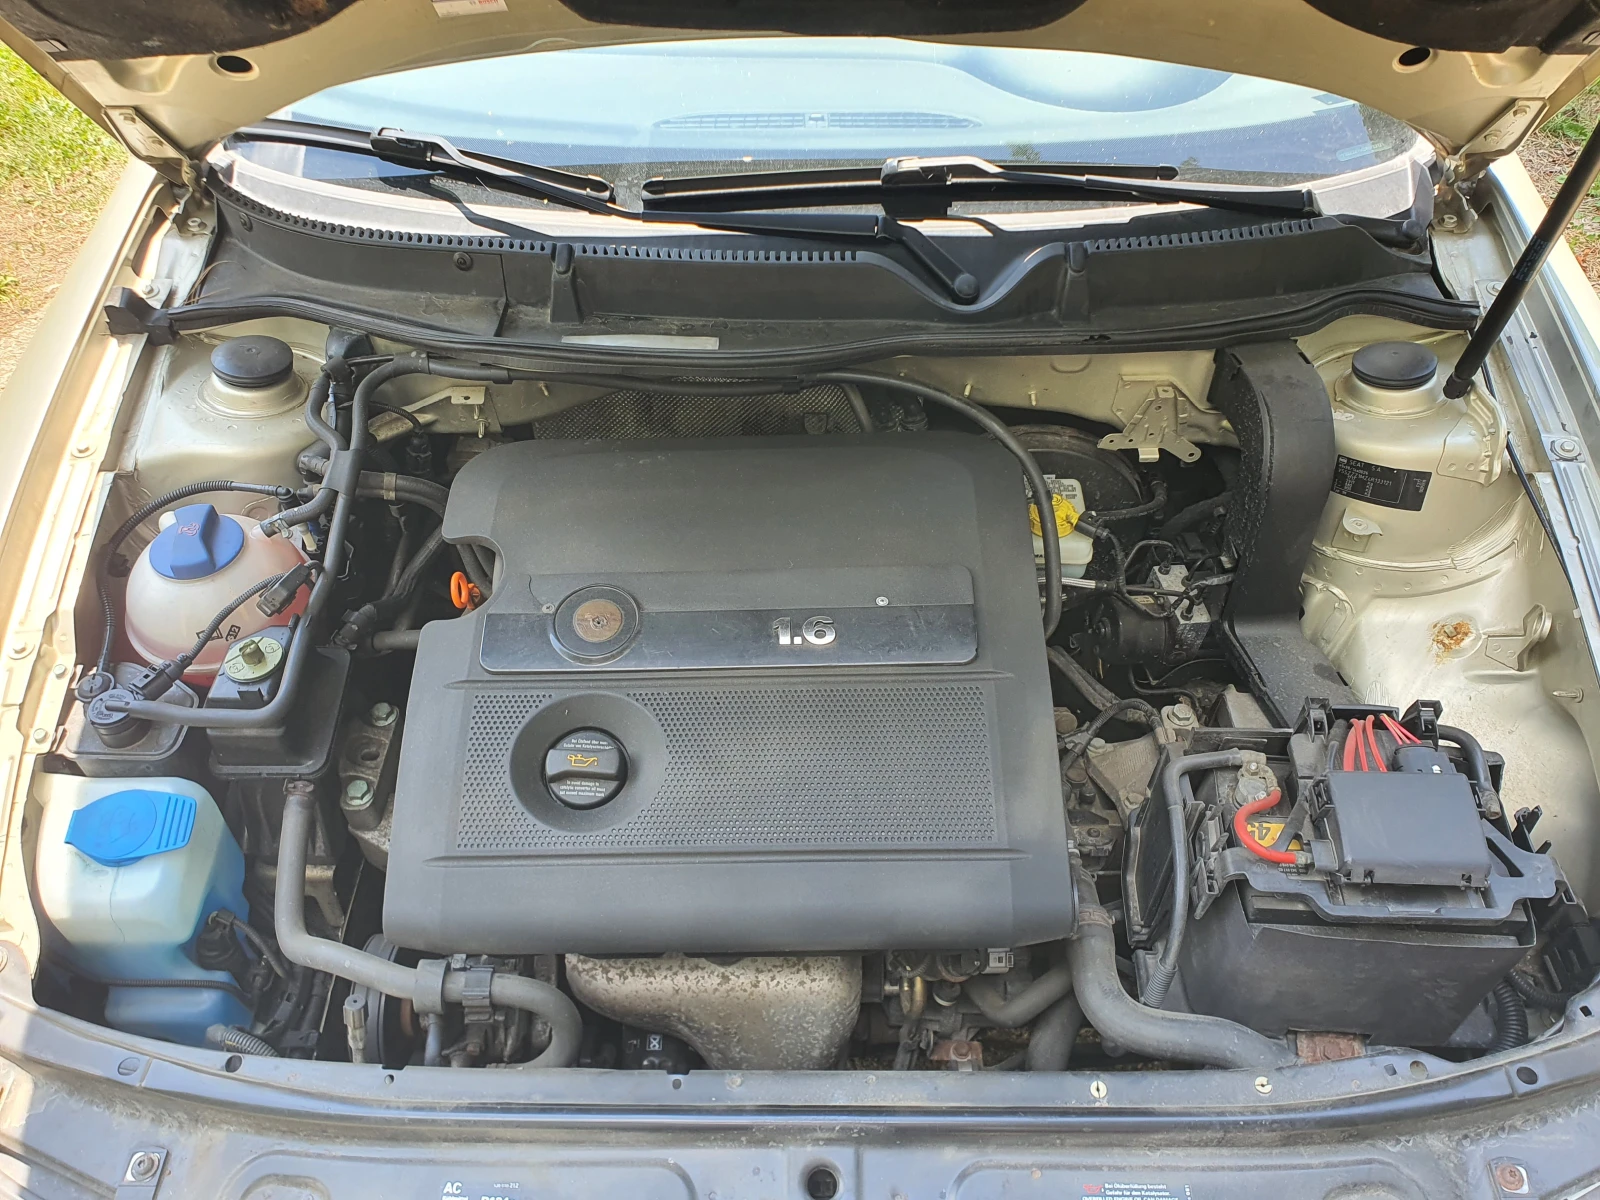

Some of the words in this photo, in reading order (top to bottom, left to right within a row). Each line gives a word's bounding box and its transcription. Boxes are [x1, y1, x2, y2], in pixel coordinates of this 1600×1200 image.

[1349, 459, 1365, 468] SEAT
[773, 615, 836, 645] 1.6
[443, 1181, 462, 1194] AC
